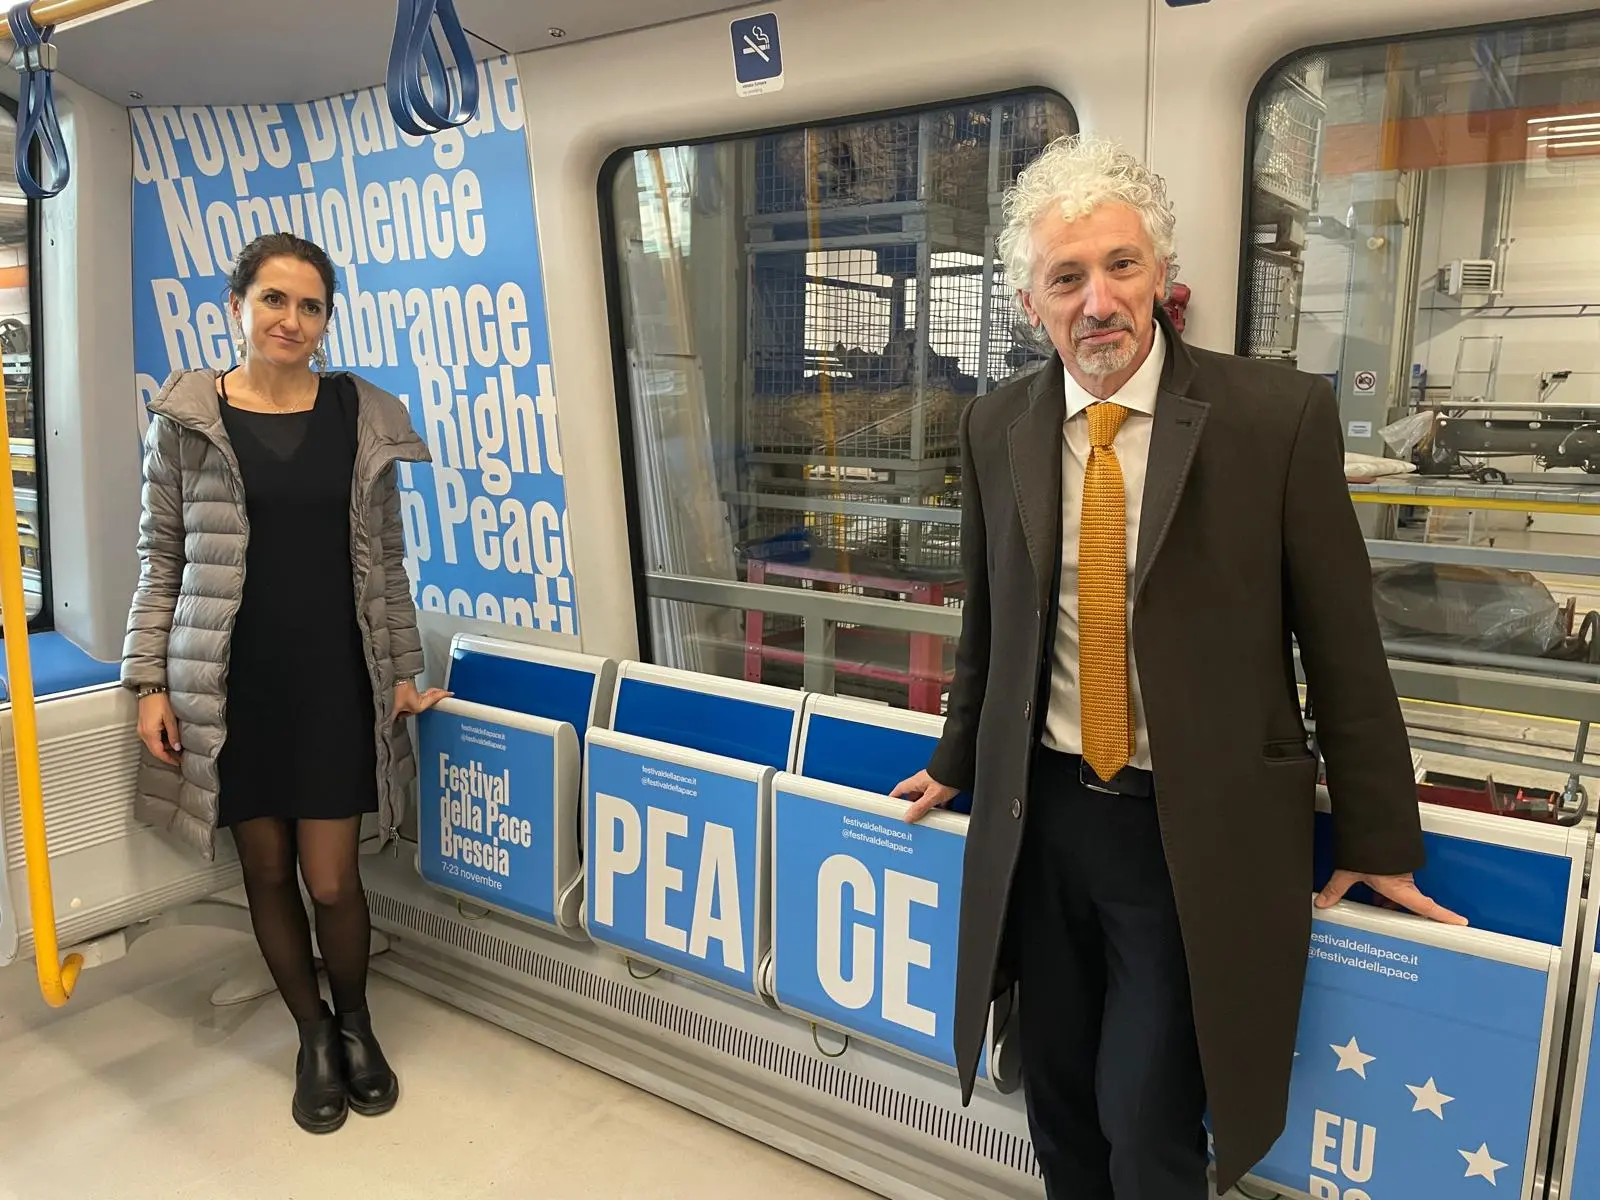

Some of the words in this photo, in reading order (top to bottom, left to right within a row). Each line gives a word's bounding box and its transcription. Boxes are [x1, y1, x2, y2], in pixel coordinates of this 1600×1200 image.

[151, 264, 531, 370] Rembrance
[439, 752, 509, 806] Festival
[440, 787, 482, 834] della
[486, 801, 531, 848] Pace
[842, 829, 914, 854] @festivaldellapace
[843, 816, 913, 841] festivaldellapace.it
[441, 819, 509, 877] Brescia
[441, 861, 459, 876] 7-23
[460, 868, 502, 890] novembre
[594, 792, 745, 973] PEA
[817, 854, 938, 1037] CE
[1310, 932, 1418, 965] estivaldellapace.it
[1311, 1109, 1376, 1183] EU
